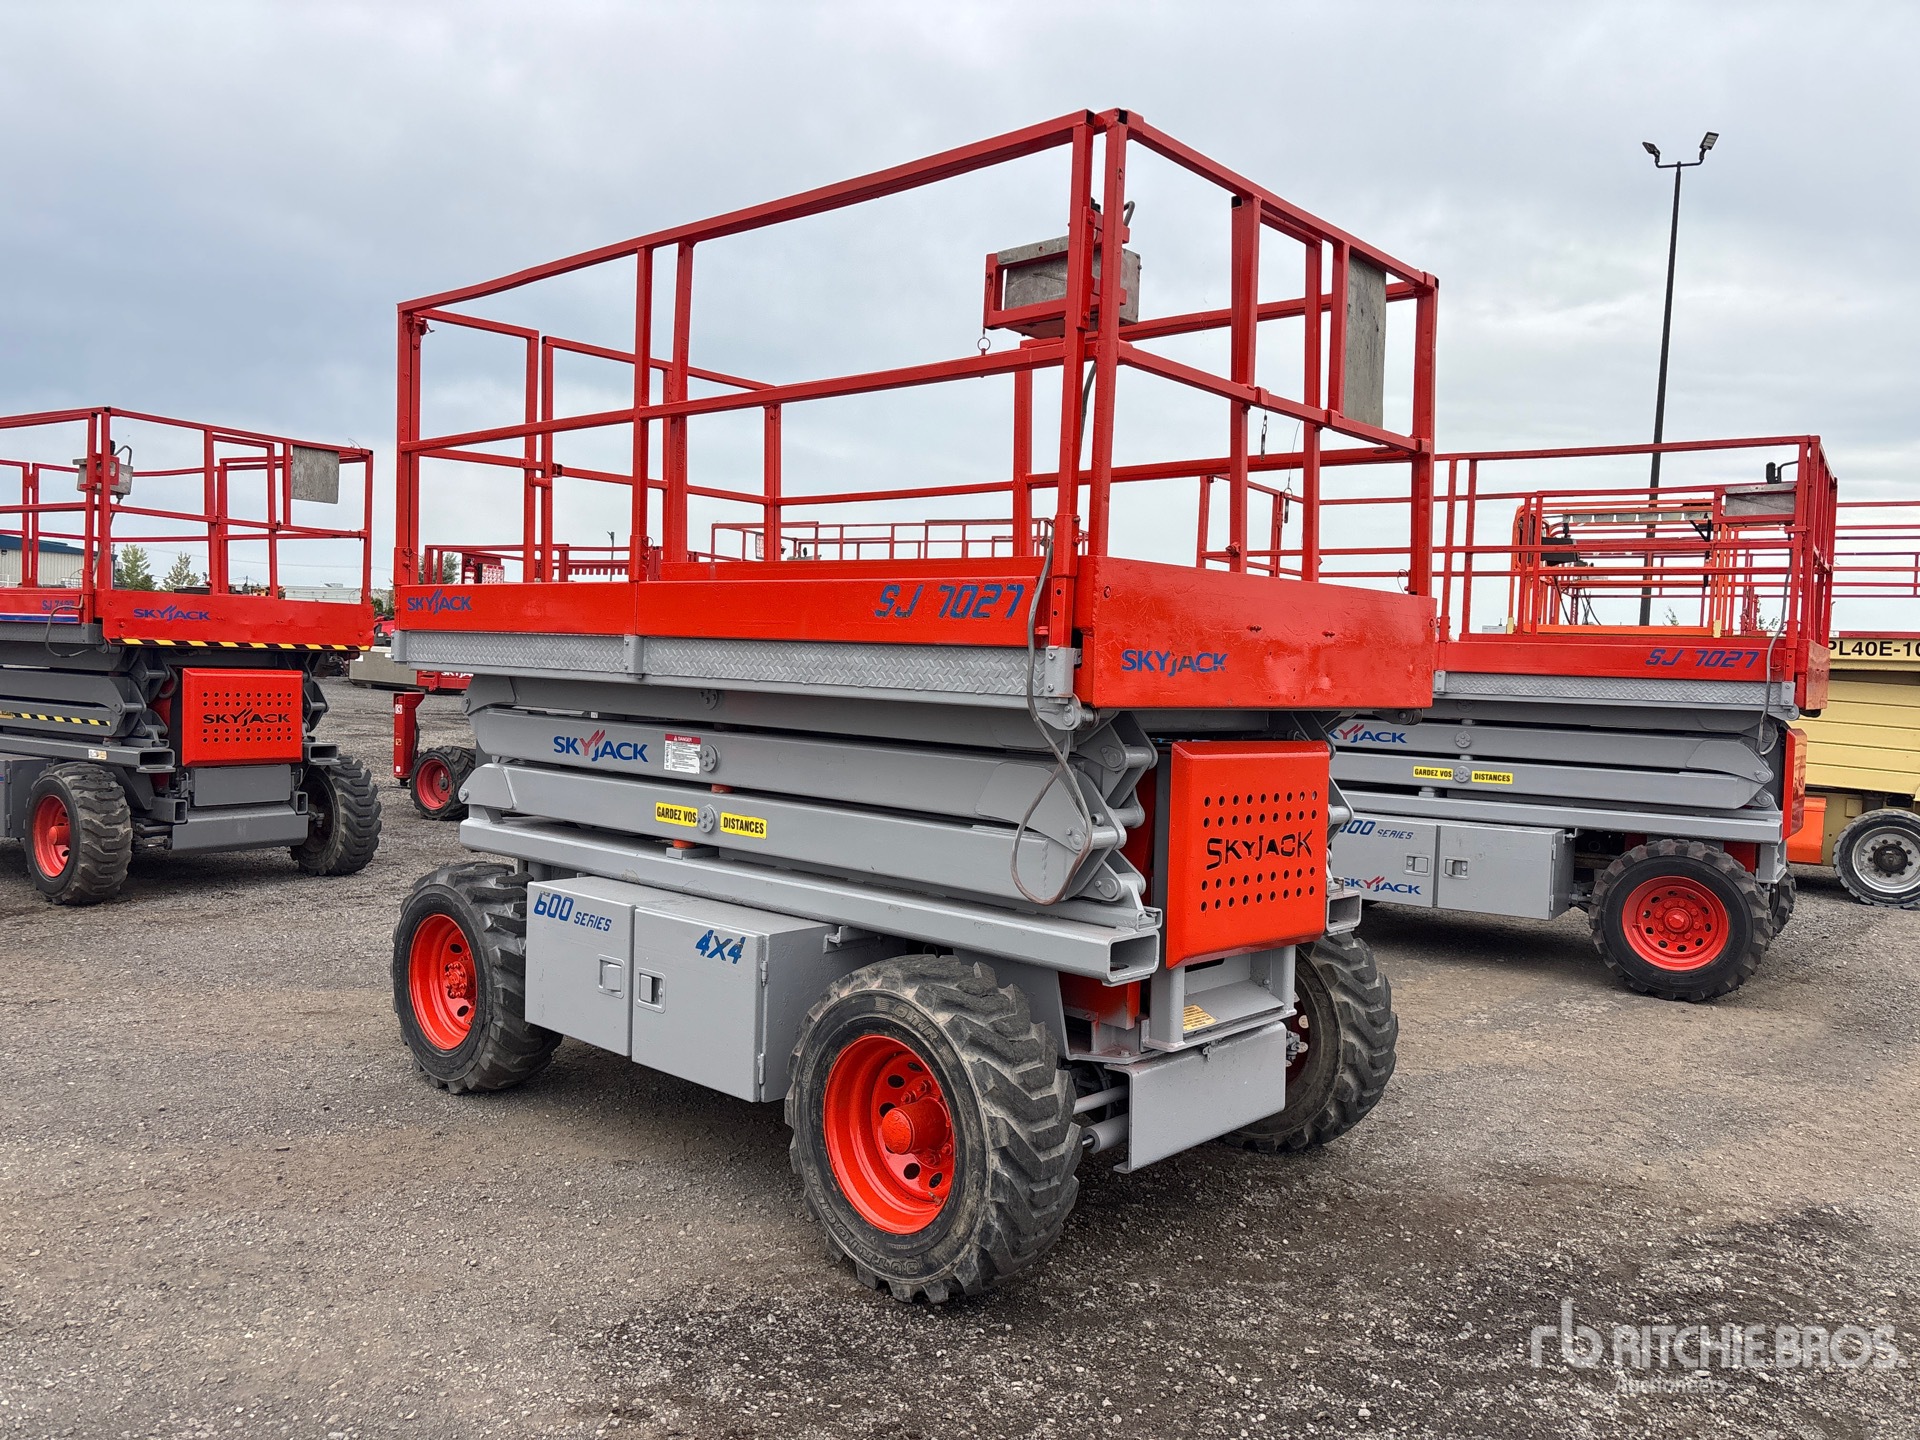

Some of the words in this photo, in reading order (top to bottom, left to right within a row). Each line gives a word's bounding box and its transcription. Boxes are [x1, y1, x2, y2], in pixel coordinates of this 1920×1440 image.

[133, 605, 211, 621] SKYJACK
[407, 588, 472, 615] SKYJACK
[874, 584, 924, 618] SJ
[938, 584, 1025, 618] 7027
[1121, 649, 1229, 678] SKYJACK
[1645, 648, 1684, 666] SJ
[1695, 650, 1760, 668] 7027
[203, 708, 291, 727] SKYJACK
[553, 729, 649, 763] SKYJACK
[1414, 768, 1439, 777] GARDEZ
[1439, 770, 1452, 778] VOS
[1474, 772, 1511, 783] DISTANCES
[656, 806, 682, 821] GARDEZ
[683, 810, 697, 824] VOS
[723, 816, 764, 835] DISTANCES
[1205, 829, 1313, 871] SKYJACK
[533, 891, 575, 922] 600
[573, 911, 613, 932] SERIES
